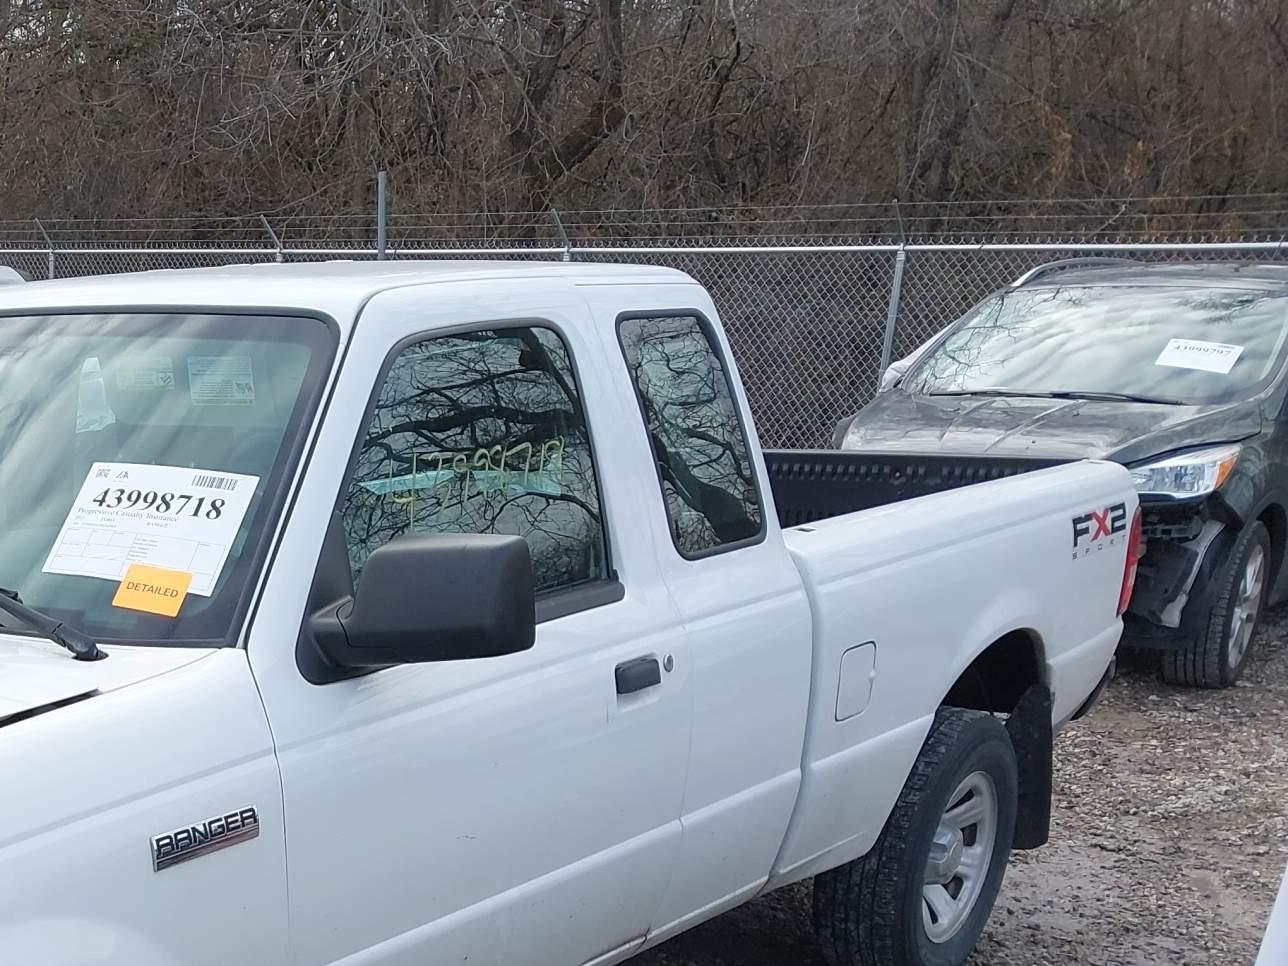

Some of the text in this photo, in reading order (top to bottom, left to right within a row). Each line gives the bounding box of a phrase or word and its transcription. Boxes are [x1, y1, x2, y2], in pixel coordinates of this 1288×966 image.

[92, 487, 226, 520] 43998718
[1072, 502, 1127, 548] FX2
[126, 581, 179, 598] DETAILED
[155, 807, 258, 859] RANGER
